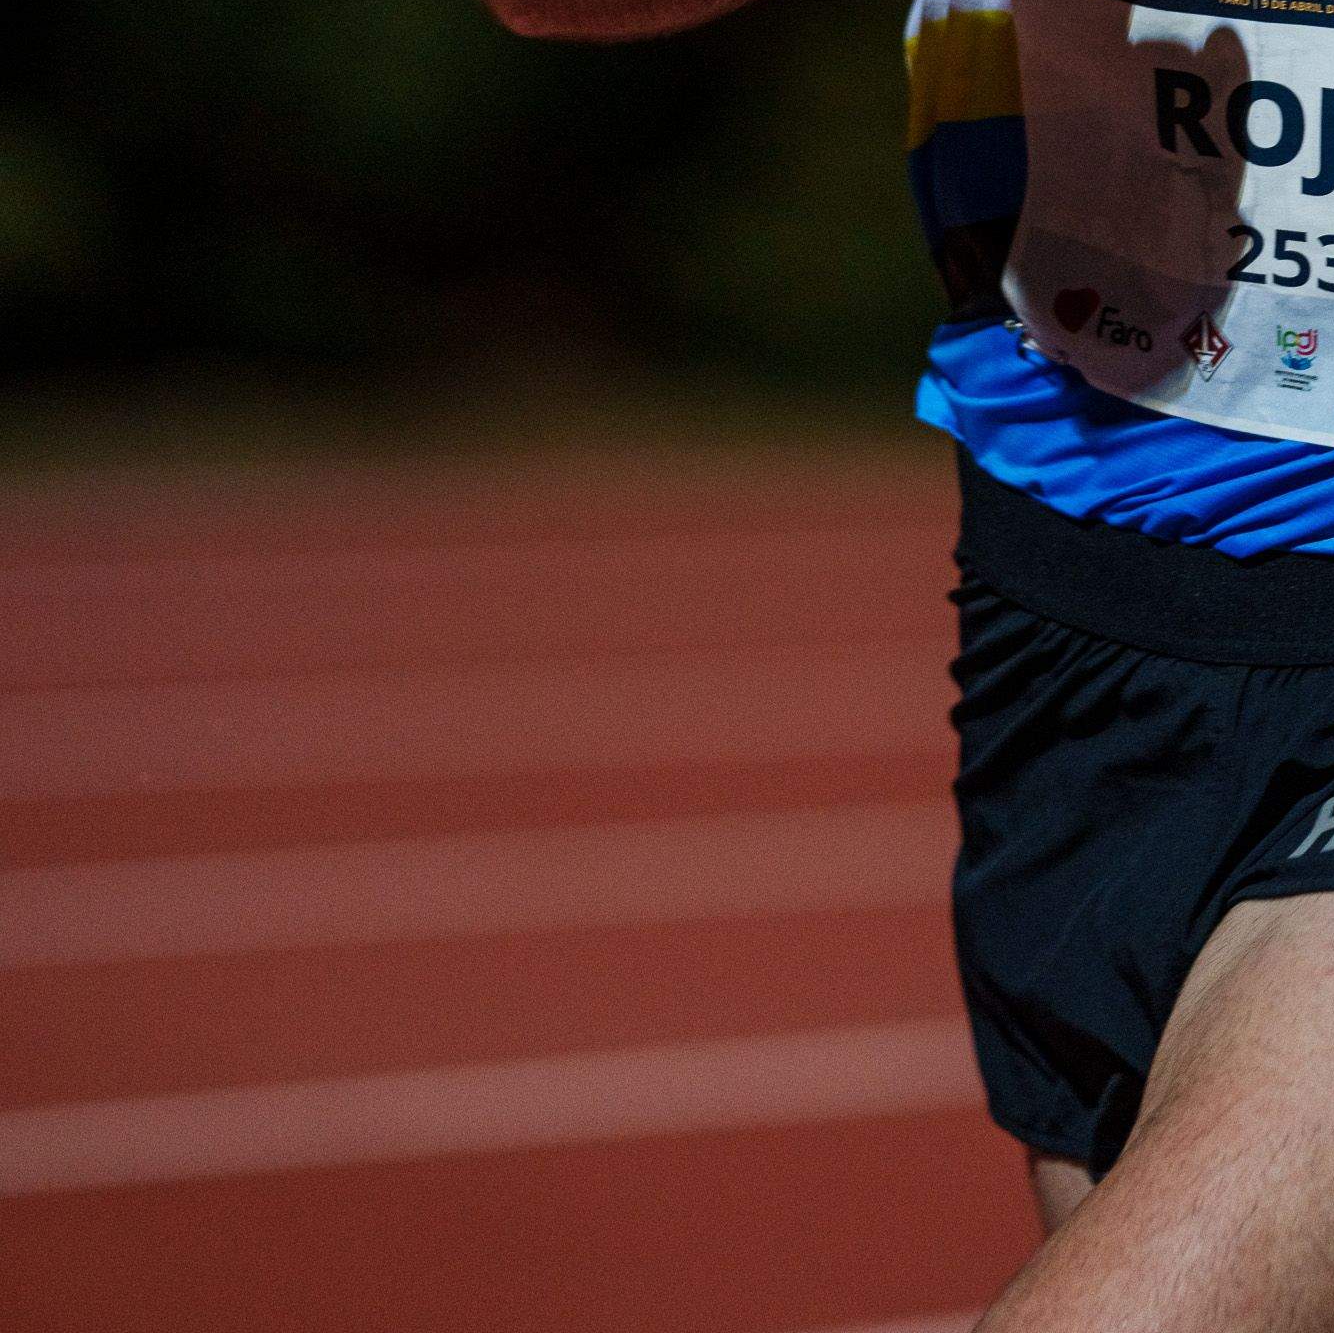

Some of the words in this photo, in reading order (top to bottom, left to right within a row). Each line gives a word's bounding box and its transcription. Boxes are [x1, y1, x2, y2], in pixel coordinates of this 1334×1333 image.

[1271, 0, 1288, 10] DE
[1288, 1, 1324, 13] ABRIL
[1096, 306, 1153, 352] Faro
